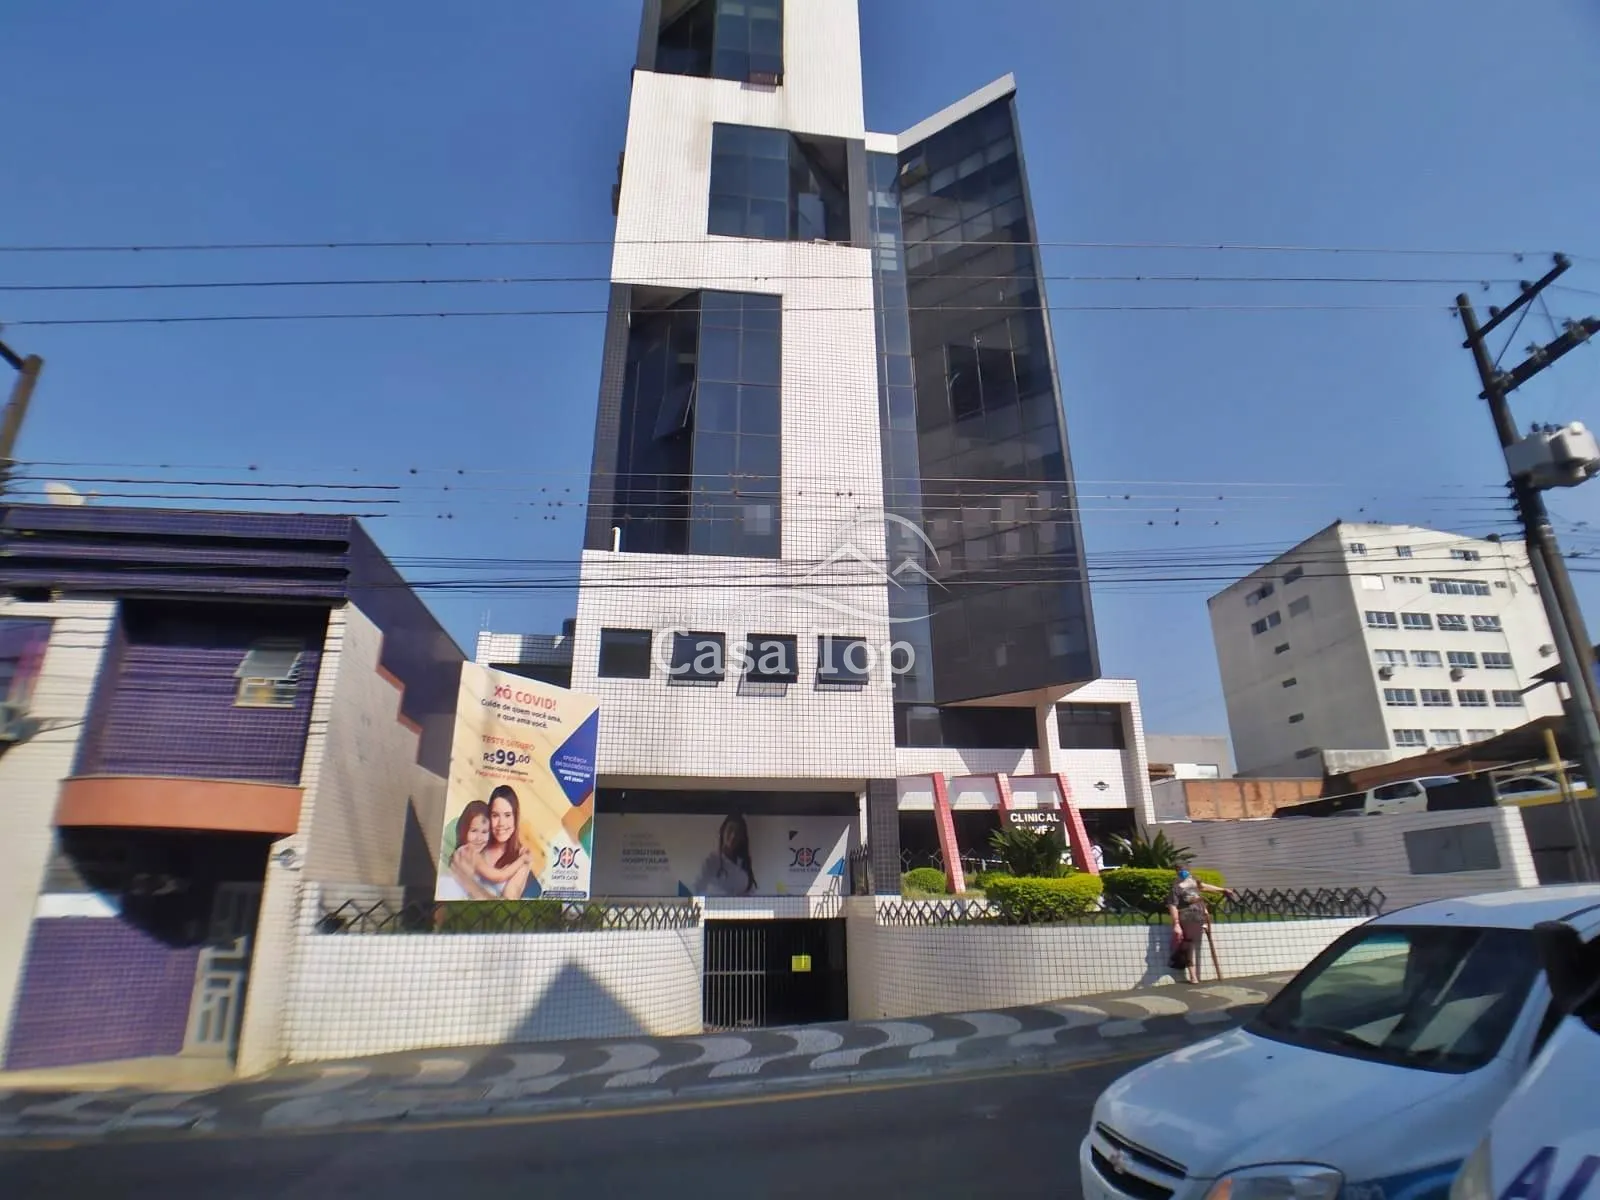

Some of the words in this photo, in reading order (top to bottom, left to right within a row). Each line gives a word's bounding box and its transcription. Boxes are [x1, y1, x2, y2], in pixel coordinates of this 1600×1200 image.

[494, 684, 512, 699] XÔ
[515, 691, 556, 711] COVID!
[481, 698, 501, 709] Cuide
[512, 706, 531, 716] quem
[532, 710, 547, 719] você
[503, 714, 516, 722] que
[516, 717, 531, 725] ama
[1010, 812, 1061, 823] CLINICAL
